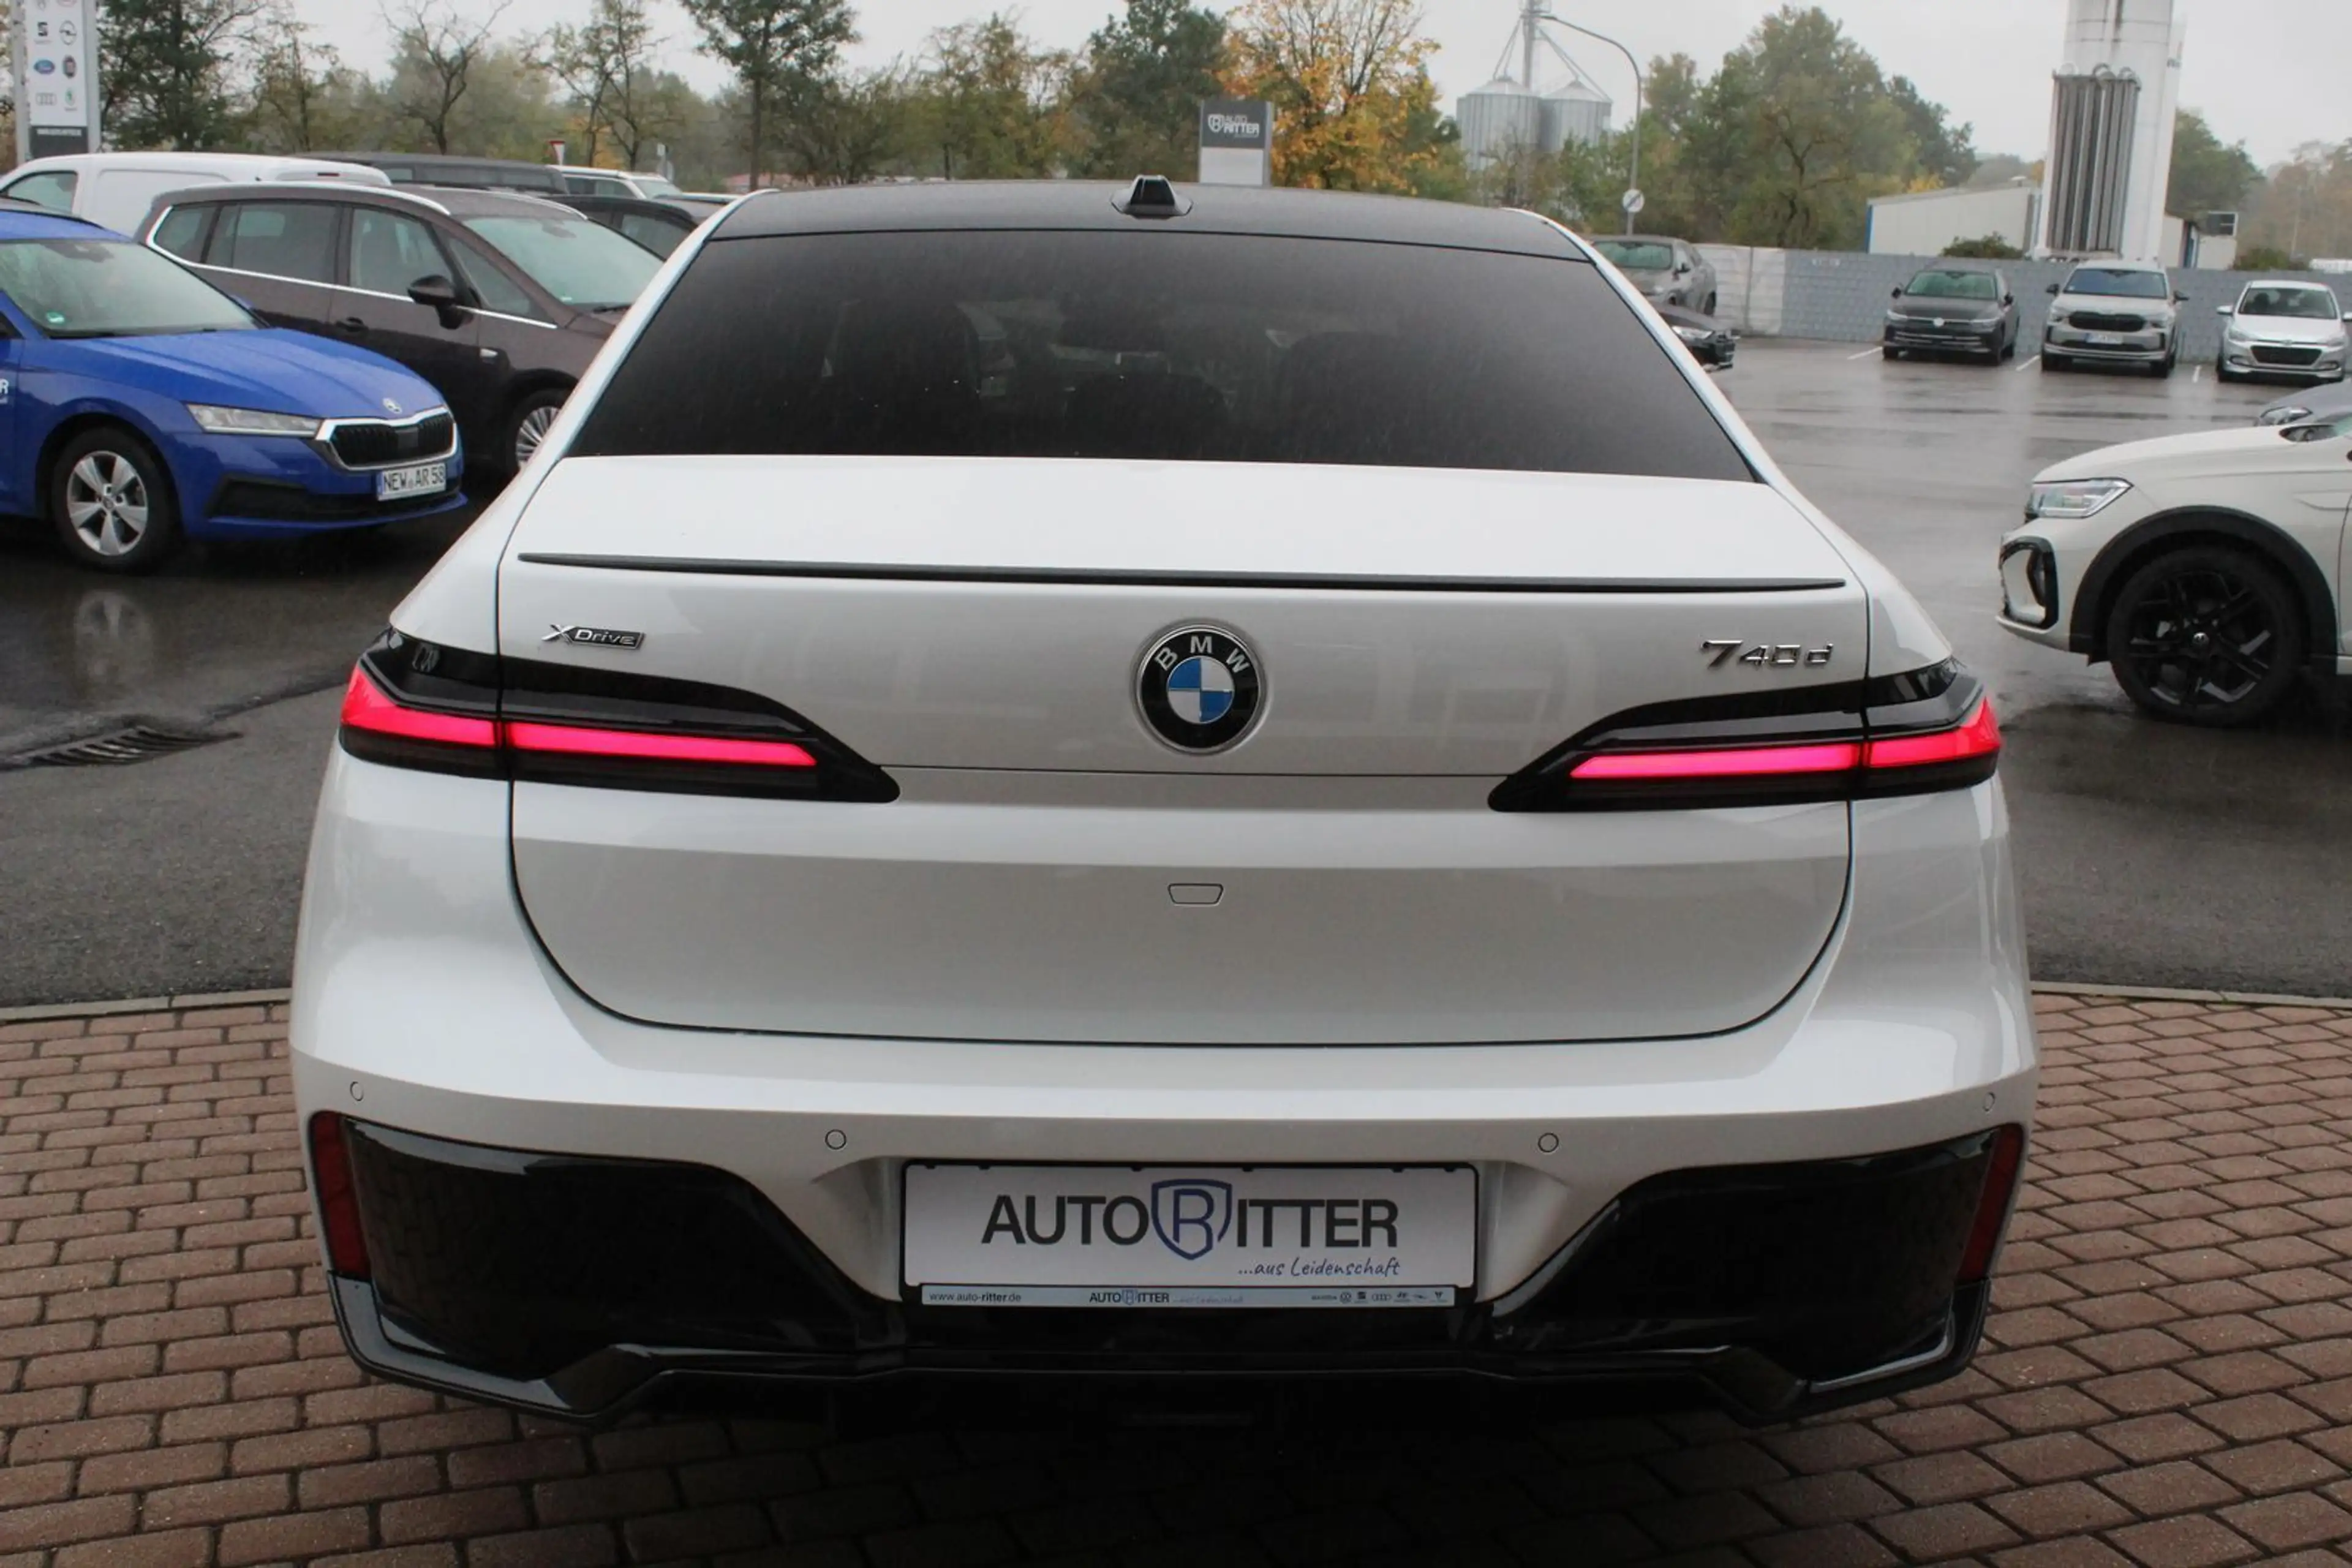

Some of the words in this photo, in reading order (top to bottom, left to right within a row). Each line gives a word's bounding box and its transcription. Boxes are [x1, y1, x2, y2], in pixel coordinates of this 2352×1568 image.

[383, 472, 407, 492] NEW
[1155, 635, 1250, 673] BMW
[1290, 1256, 1400, 1277] Leidenschaft
[929, 1292, 1021, 1303] www.auto-ritter.de
